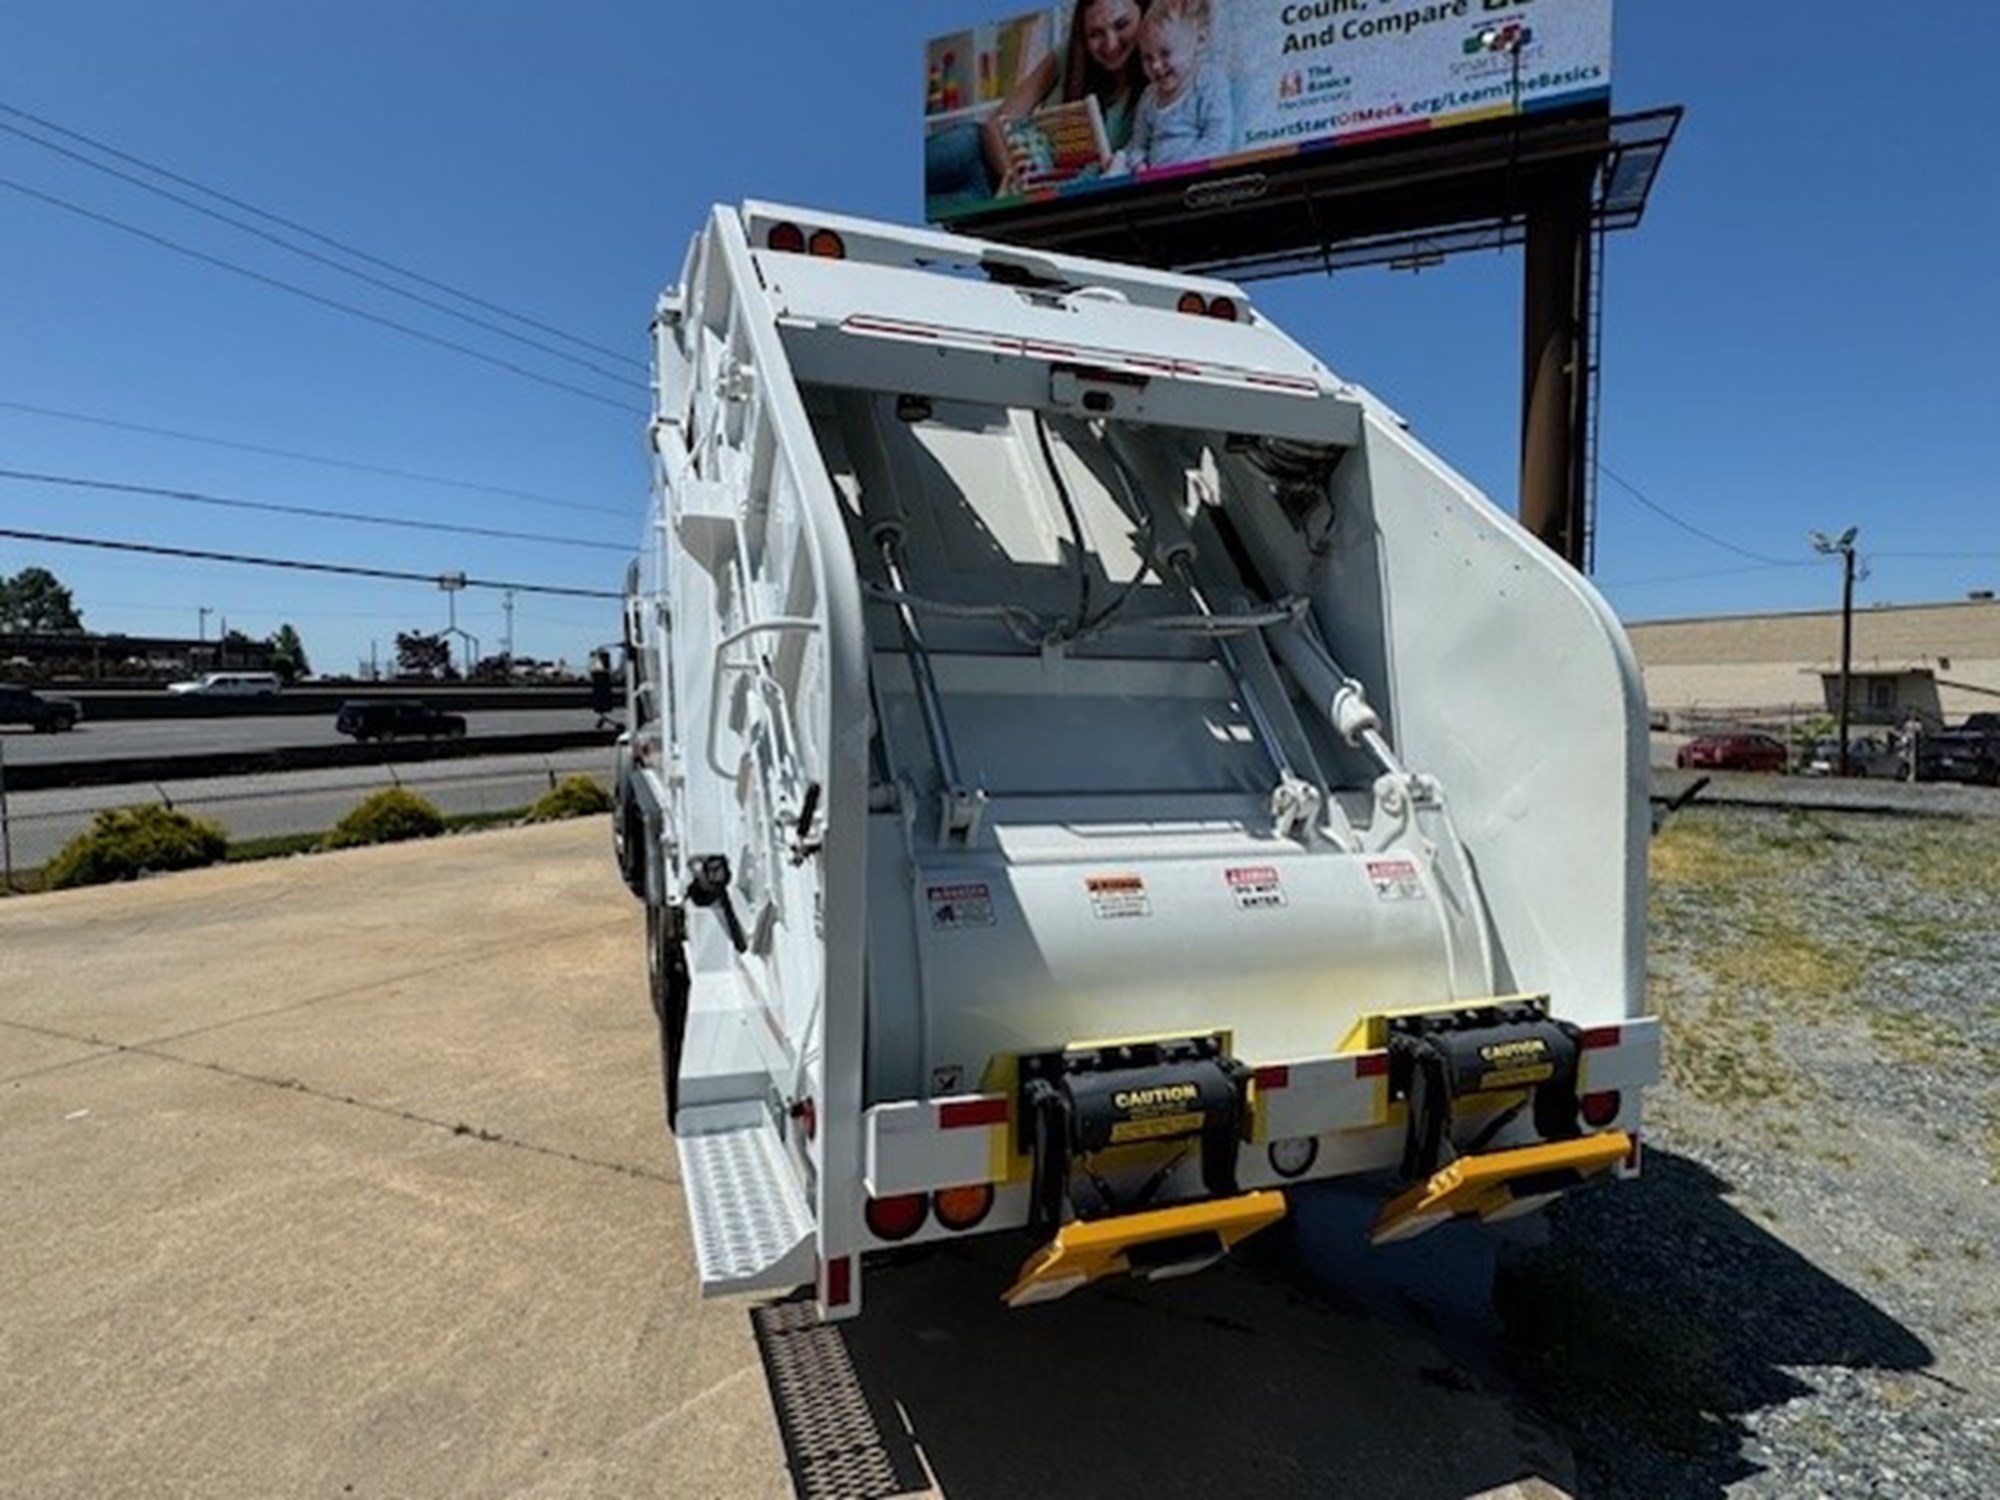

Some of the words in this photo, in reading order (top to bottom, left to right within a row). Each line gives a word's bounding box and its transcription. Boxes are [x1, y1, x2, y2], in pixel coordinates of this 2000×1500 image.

[1281, 0, 1367, 26] Count,
[1282, 24, 1335, 54] And
[1342, 0, 1467, 40] Compare
[1481, 1040, 1546, 1061] CAUTION
[1114, 1085, 1198, 1109] CAUTION
